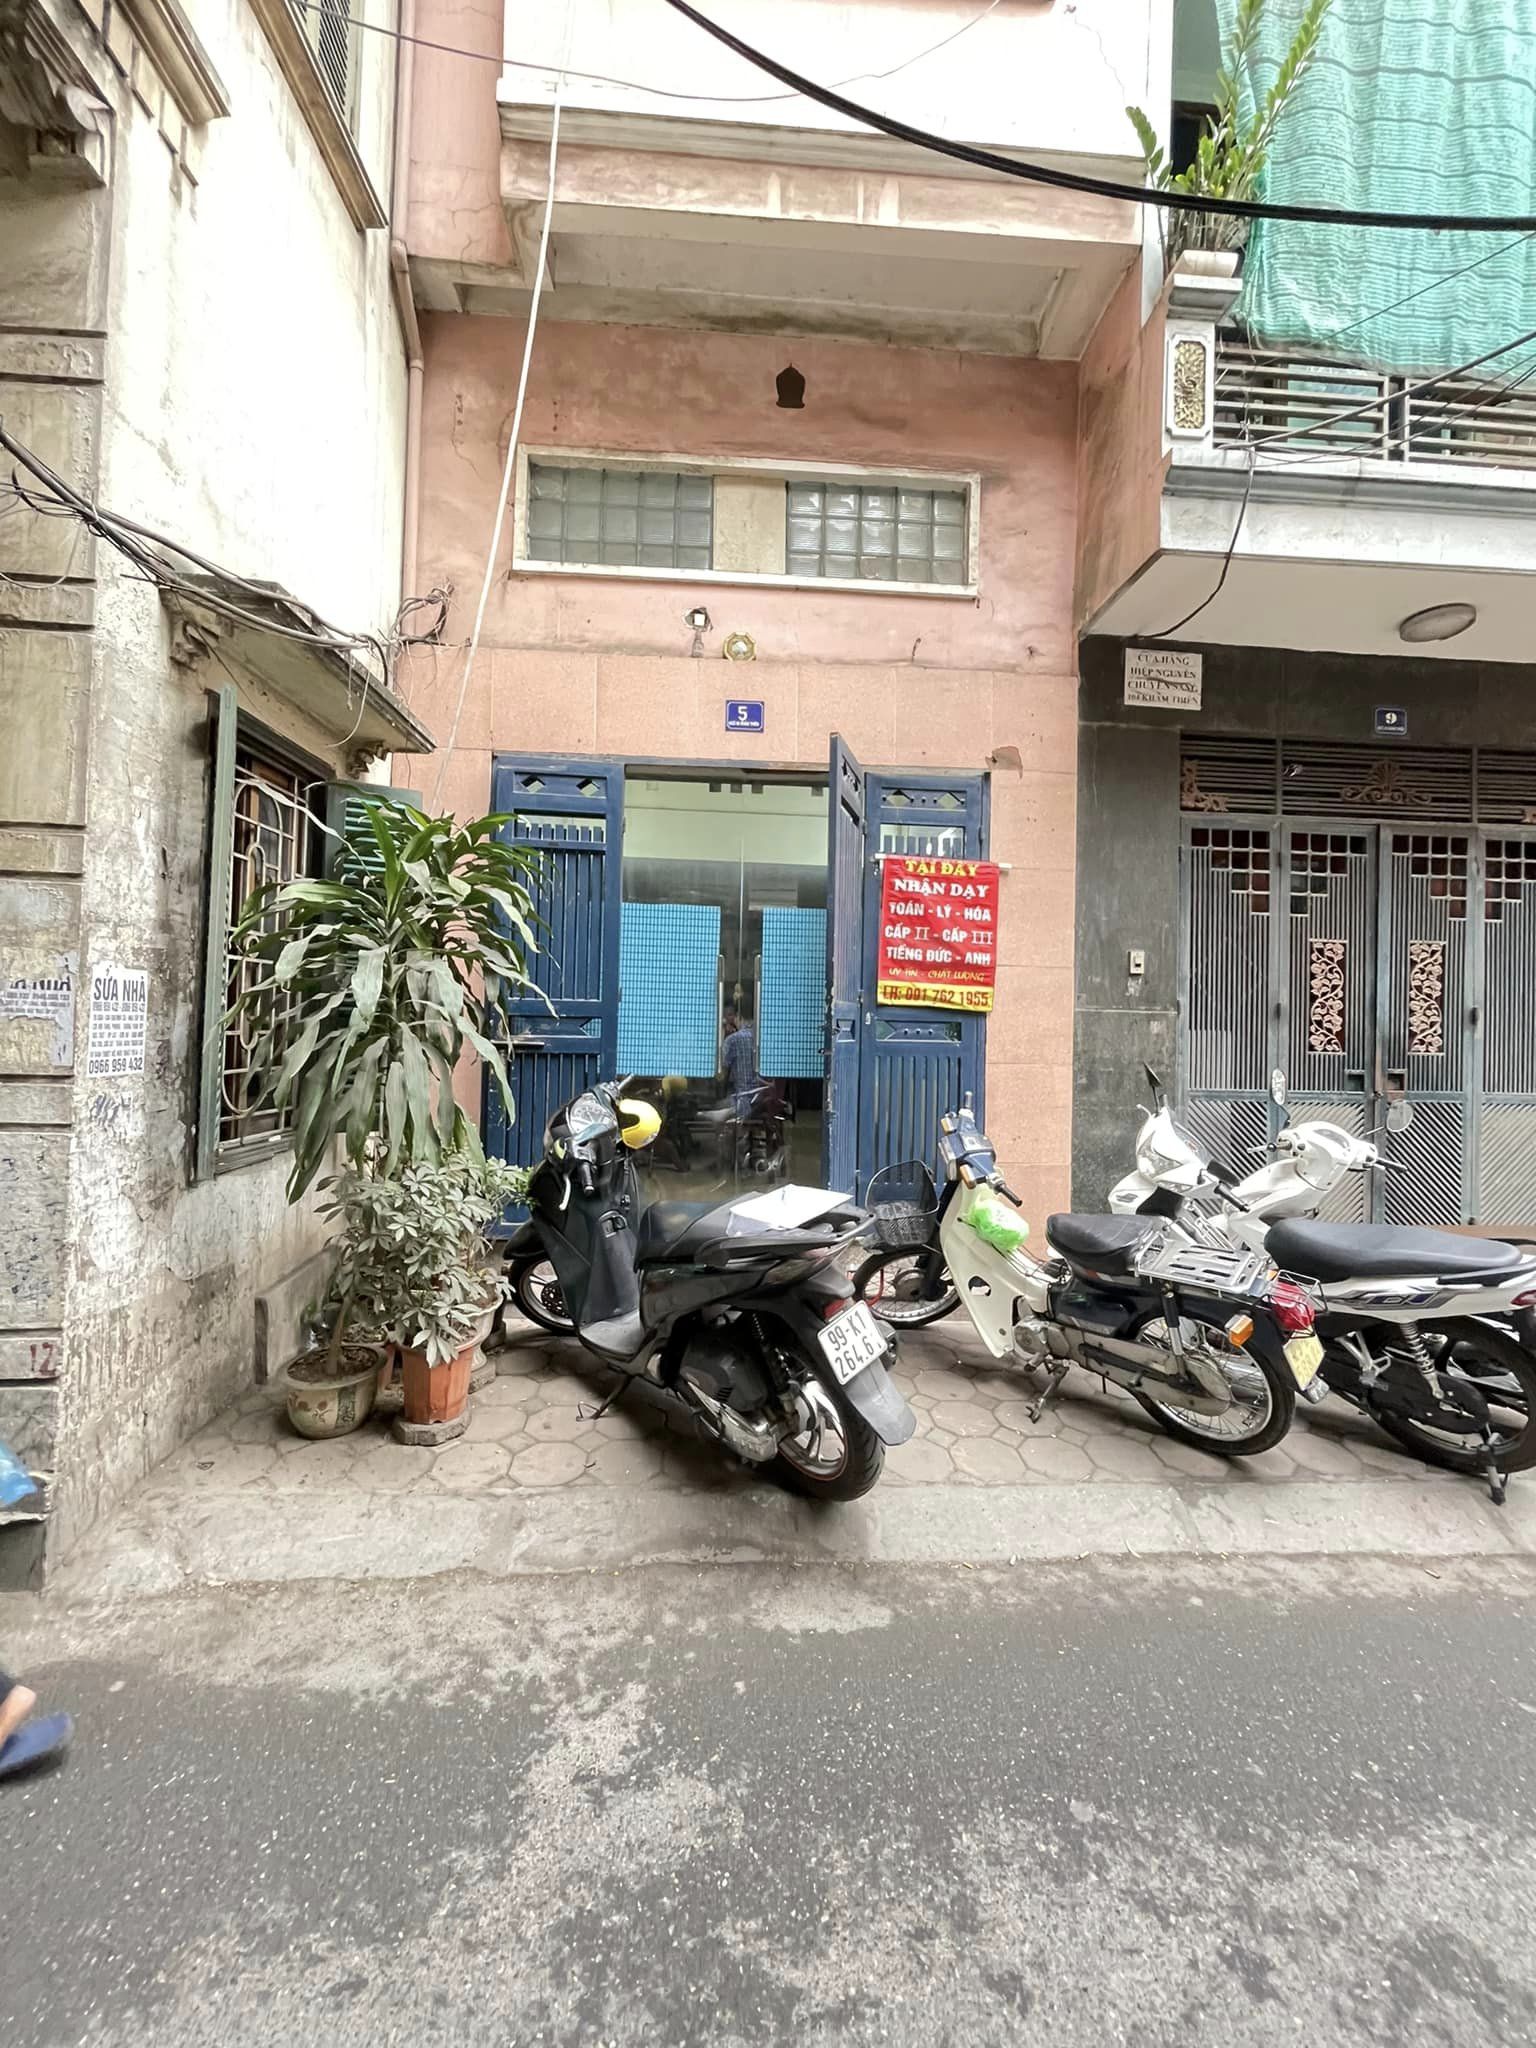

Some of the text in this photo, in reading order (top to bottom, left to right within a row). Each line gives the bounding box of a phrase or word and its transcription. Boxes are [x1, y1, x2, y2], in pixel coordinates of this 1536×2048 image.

[738, 705, 748, 721] 5
[1385, 712, 1397, 725] 9
[894, 878, 989, 900] NHẬN DẠY
[889, 900, 925, 916] TOÁN
[936, 904, 952, 918] LÝ
[964, 905, 991, 922] HÓA
[885, 922, 911, 939] CẤP
[914, 926, 930, 941] II
[942, 926, 968, 942] CẤP
[971, 930, 993, 945] III
[886, 944, 923, 961] TIẾNG
[926, 946, 952, 963] ĐỨC
[965, 951, 991, 966] ANH
[122, 976, 146, 1003] NHÀ
[906, 987, 928, 1001] 091
[932, 989, 955, 1003] 762
[88, 1057, 143, 1074] 0966 959 432
[827, 1311, 866, 1351] 99-K1
[30, 1342, 57, 1376] 12
[835, 1336, 882, 1378] 264.6
